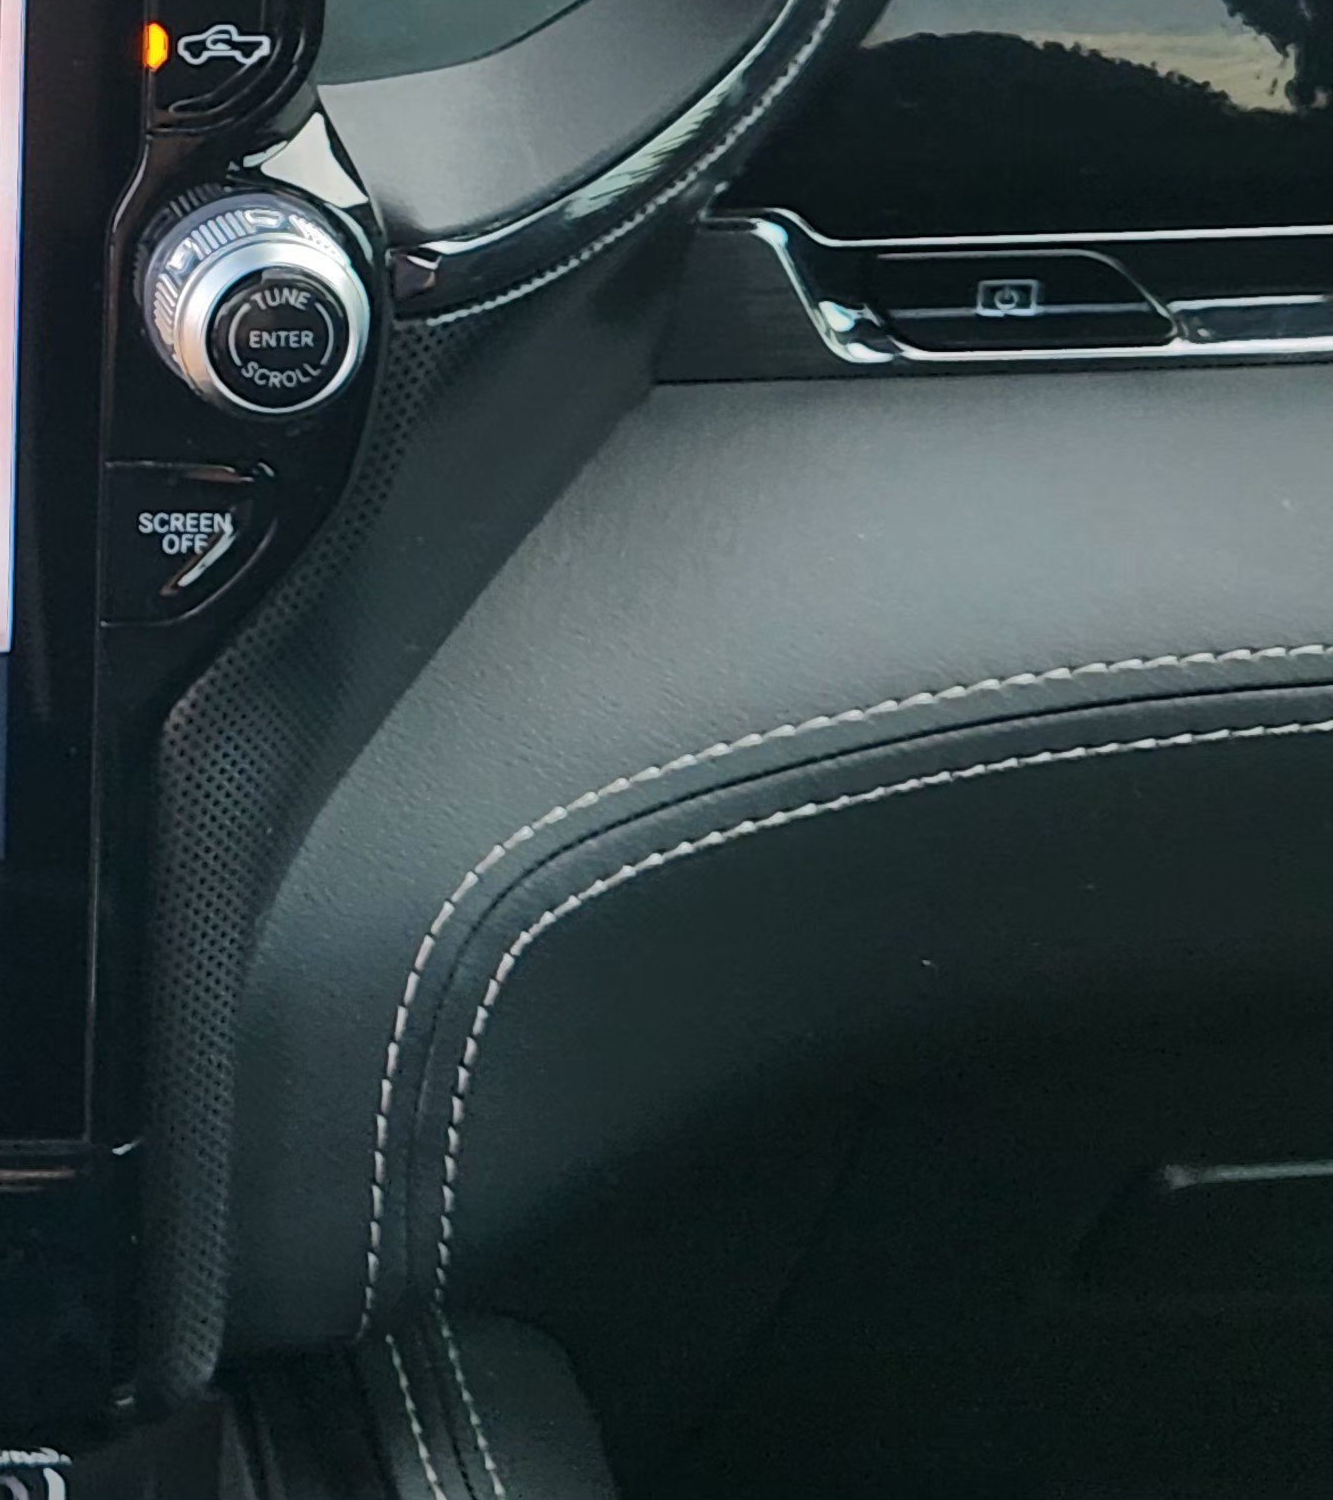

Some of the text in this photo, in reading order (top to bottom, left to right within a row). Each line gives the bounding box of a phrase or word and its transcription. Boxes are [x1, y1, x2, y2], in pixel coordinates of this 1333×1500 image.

[251, 287, 312, 311] TUNE
[249, 330, 315, 349] ENTER
[240, 361, 322, 389] SCROLL
[138, 512, 231, 533] SCREEN
[162, 534, 208, 555] OFF
